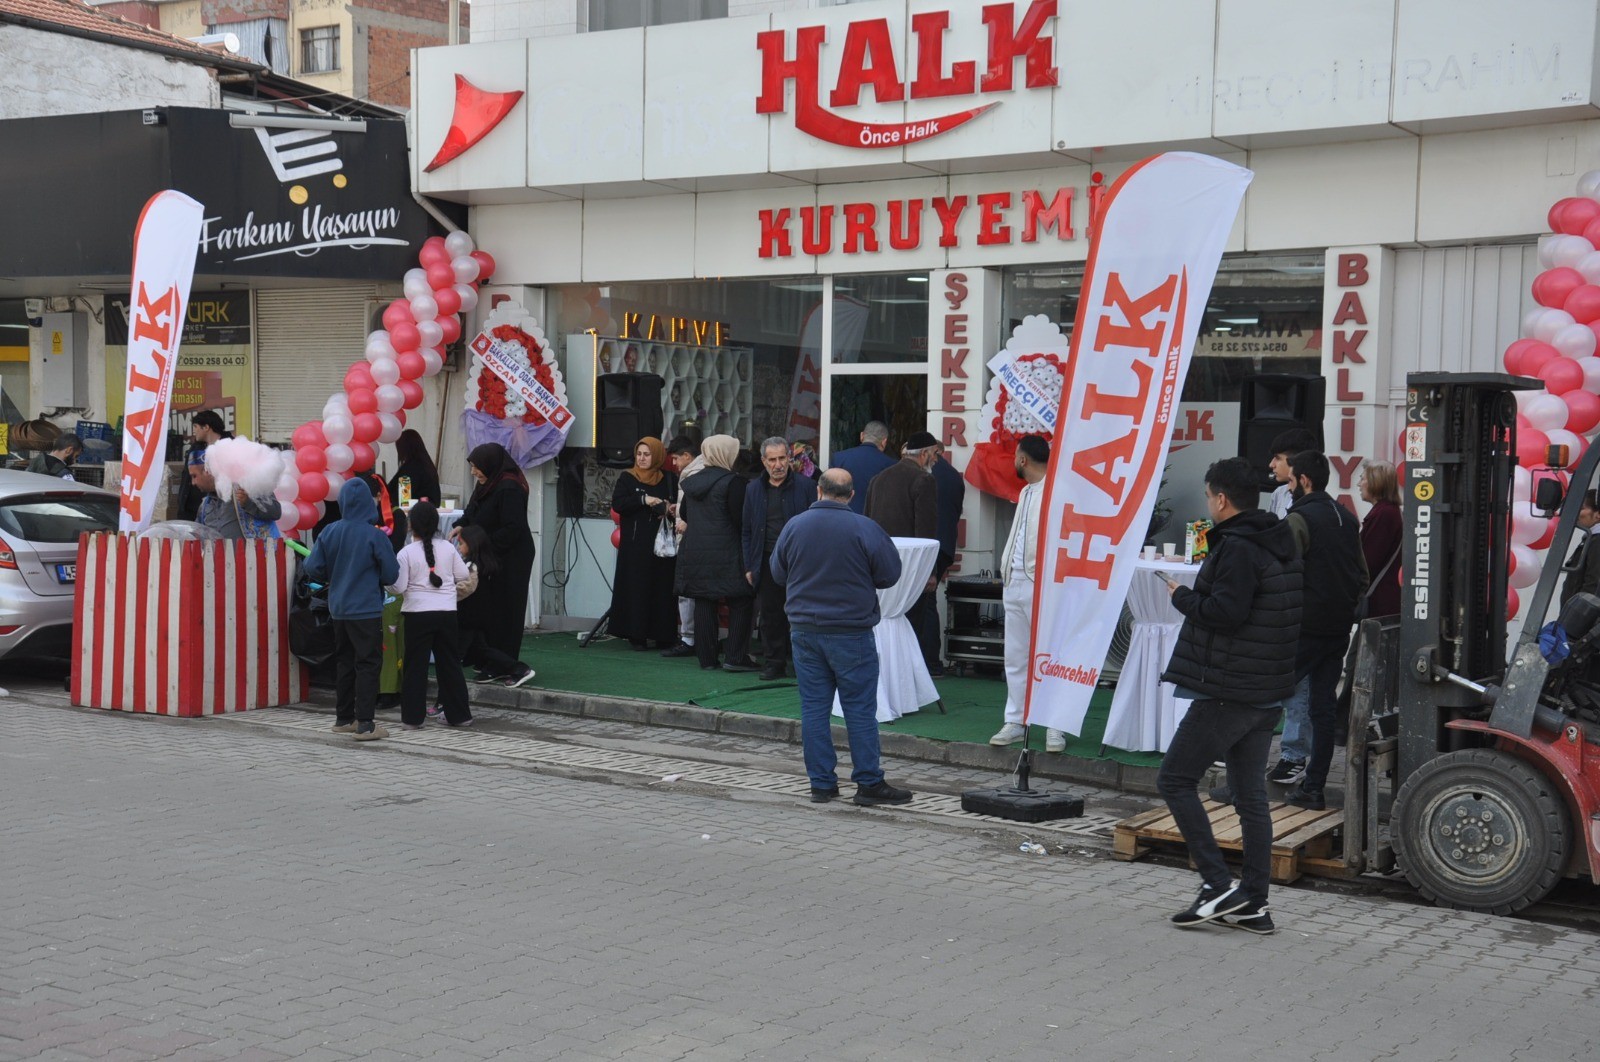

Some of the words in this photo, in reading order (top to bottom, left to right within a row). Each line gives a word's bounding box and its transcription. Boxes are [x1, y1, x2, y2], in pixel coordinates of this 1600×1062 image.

[755, 0, 1059, 130] HALK
[859, 126, 900, 146] Önce
[904, 120, 939, 140] Halk
[199, 210, 295, 254] Farkını
[302, 203, 401, 250] Yaşayın
[757, 170, 1107, 259] KURUYEMİ
[184, 324, 204, 332] RKET
[187, 301, 230, 322] ÜRK
[174, 377, 186, 389] lar
[187, 376, 203, 389] Sizi
[183, 357, 204, 365] 0530
[206, 357, 221, 365] 258
[223, 357, 233, 365] 04
[485, 354, 518, 385] ÖZCAN
[521, 386, 551, 415] ÇETİN
[489, 344, 520, 375] BAKKALLAR
[518, 371, 537, 389] ODASI
[534, 386, 559, 410] BAŞKANI
[1165, 345, 1182, 382] halk
[118, 281, 174, 523] HALK
[999, 363, 1040, 408] KİREÇÇİ
[1037, 404, 1057, 428] İB
[1157, 384, 1174, 424] önce
[1053, 271, 1178, 591] HALK
[1419, 484, 1429, 498] 5
[1411, 504, 1431, 621] asimato
